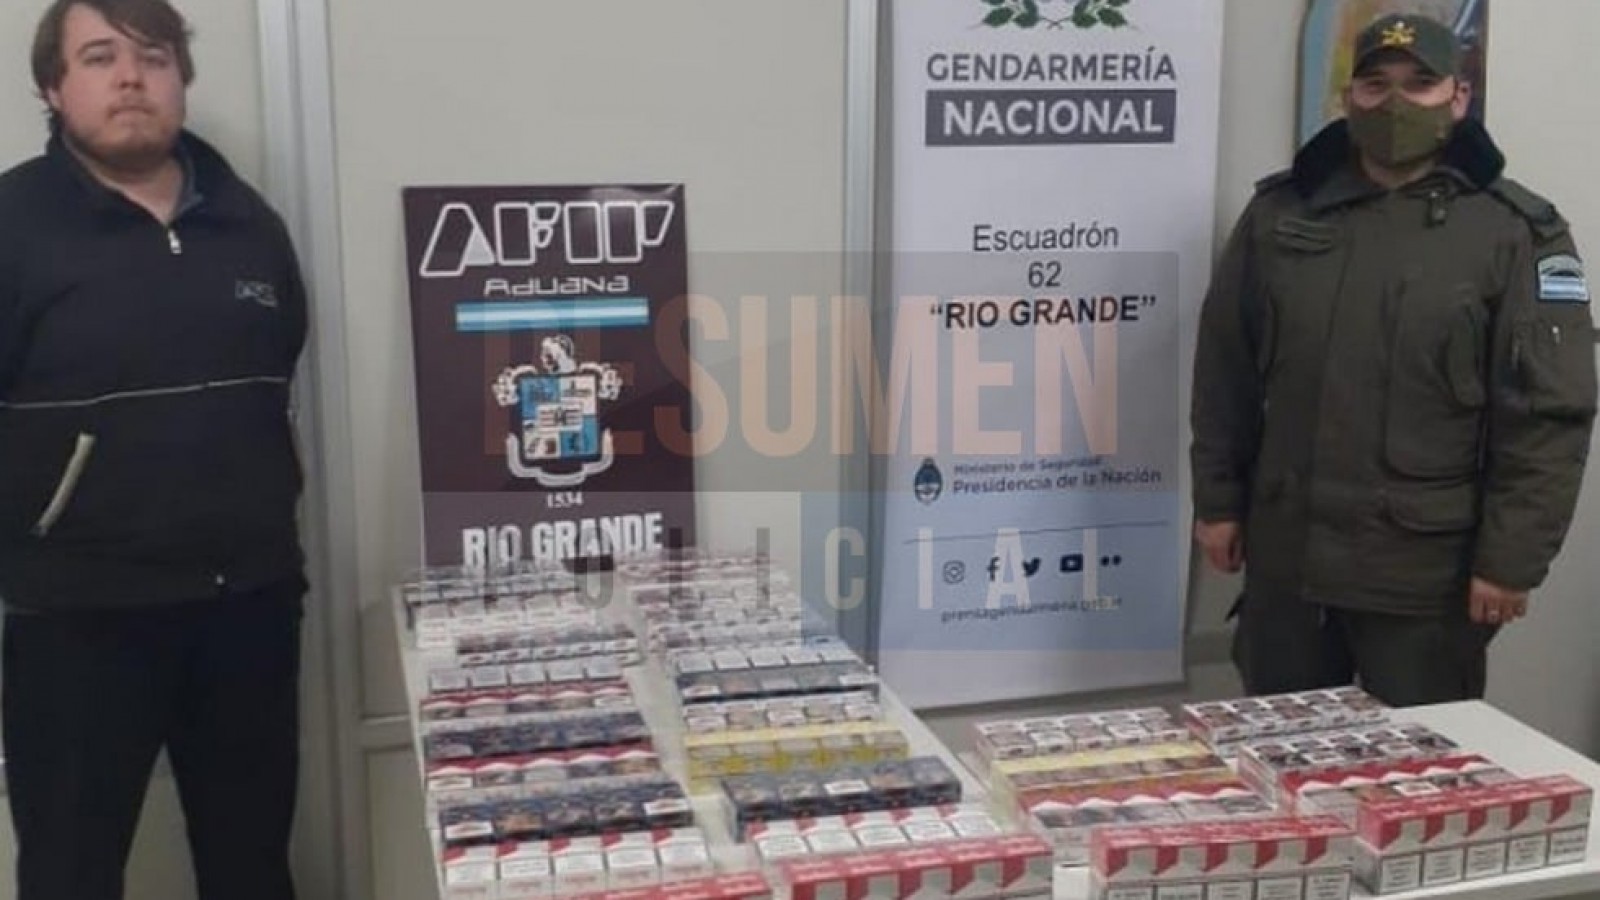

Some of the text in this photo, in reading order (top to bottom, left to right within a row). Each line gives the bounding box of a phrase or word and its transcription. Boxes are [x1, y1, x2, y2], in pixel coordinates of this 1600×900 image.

[926, 46, 1177, 82] GENDARMERÍA
[943, 99, 1164, 136] NACIONAL
[419, 201, 675, 278] AFIP
[972, 222, 1119, 251] Escuadrón
[1027, 261, 1062, 289] 62
[953, 477, 1053, 493] Presidencia
[1057, 473, 1080, 488] de
[1102, 467, 1162, 484] Nación
[462, 512, 664, 571] RIO GRANDE
